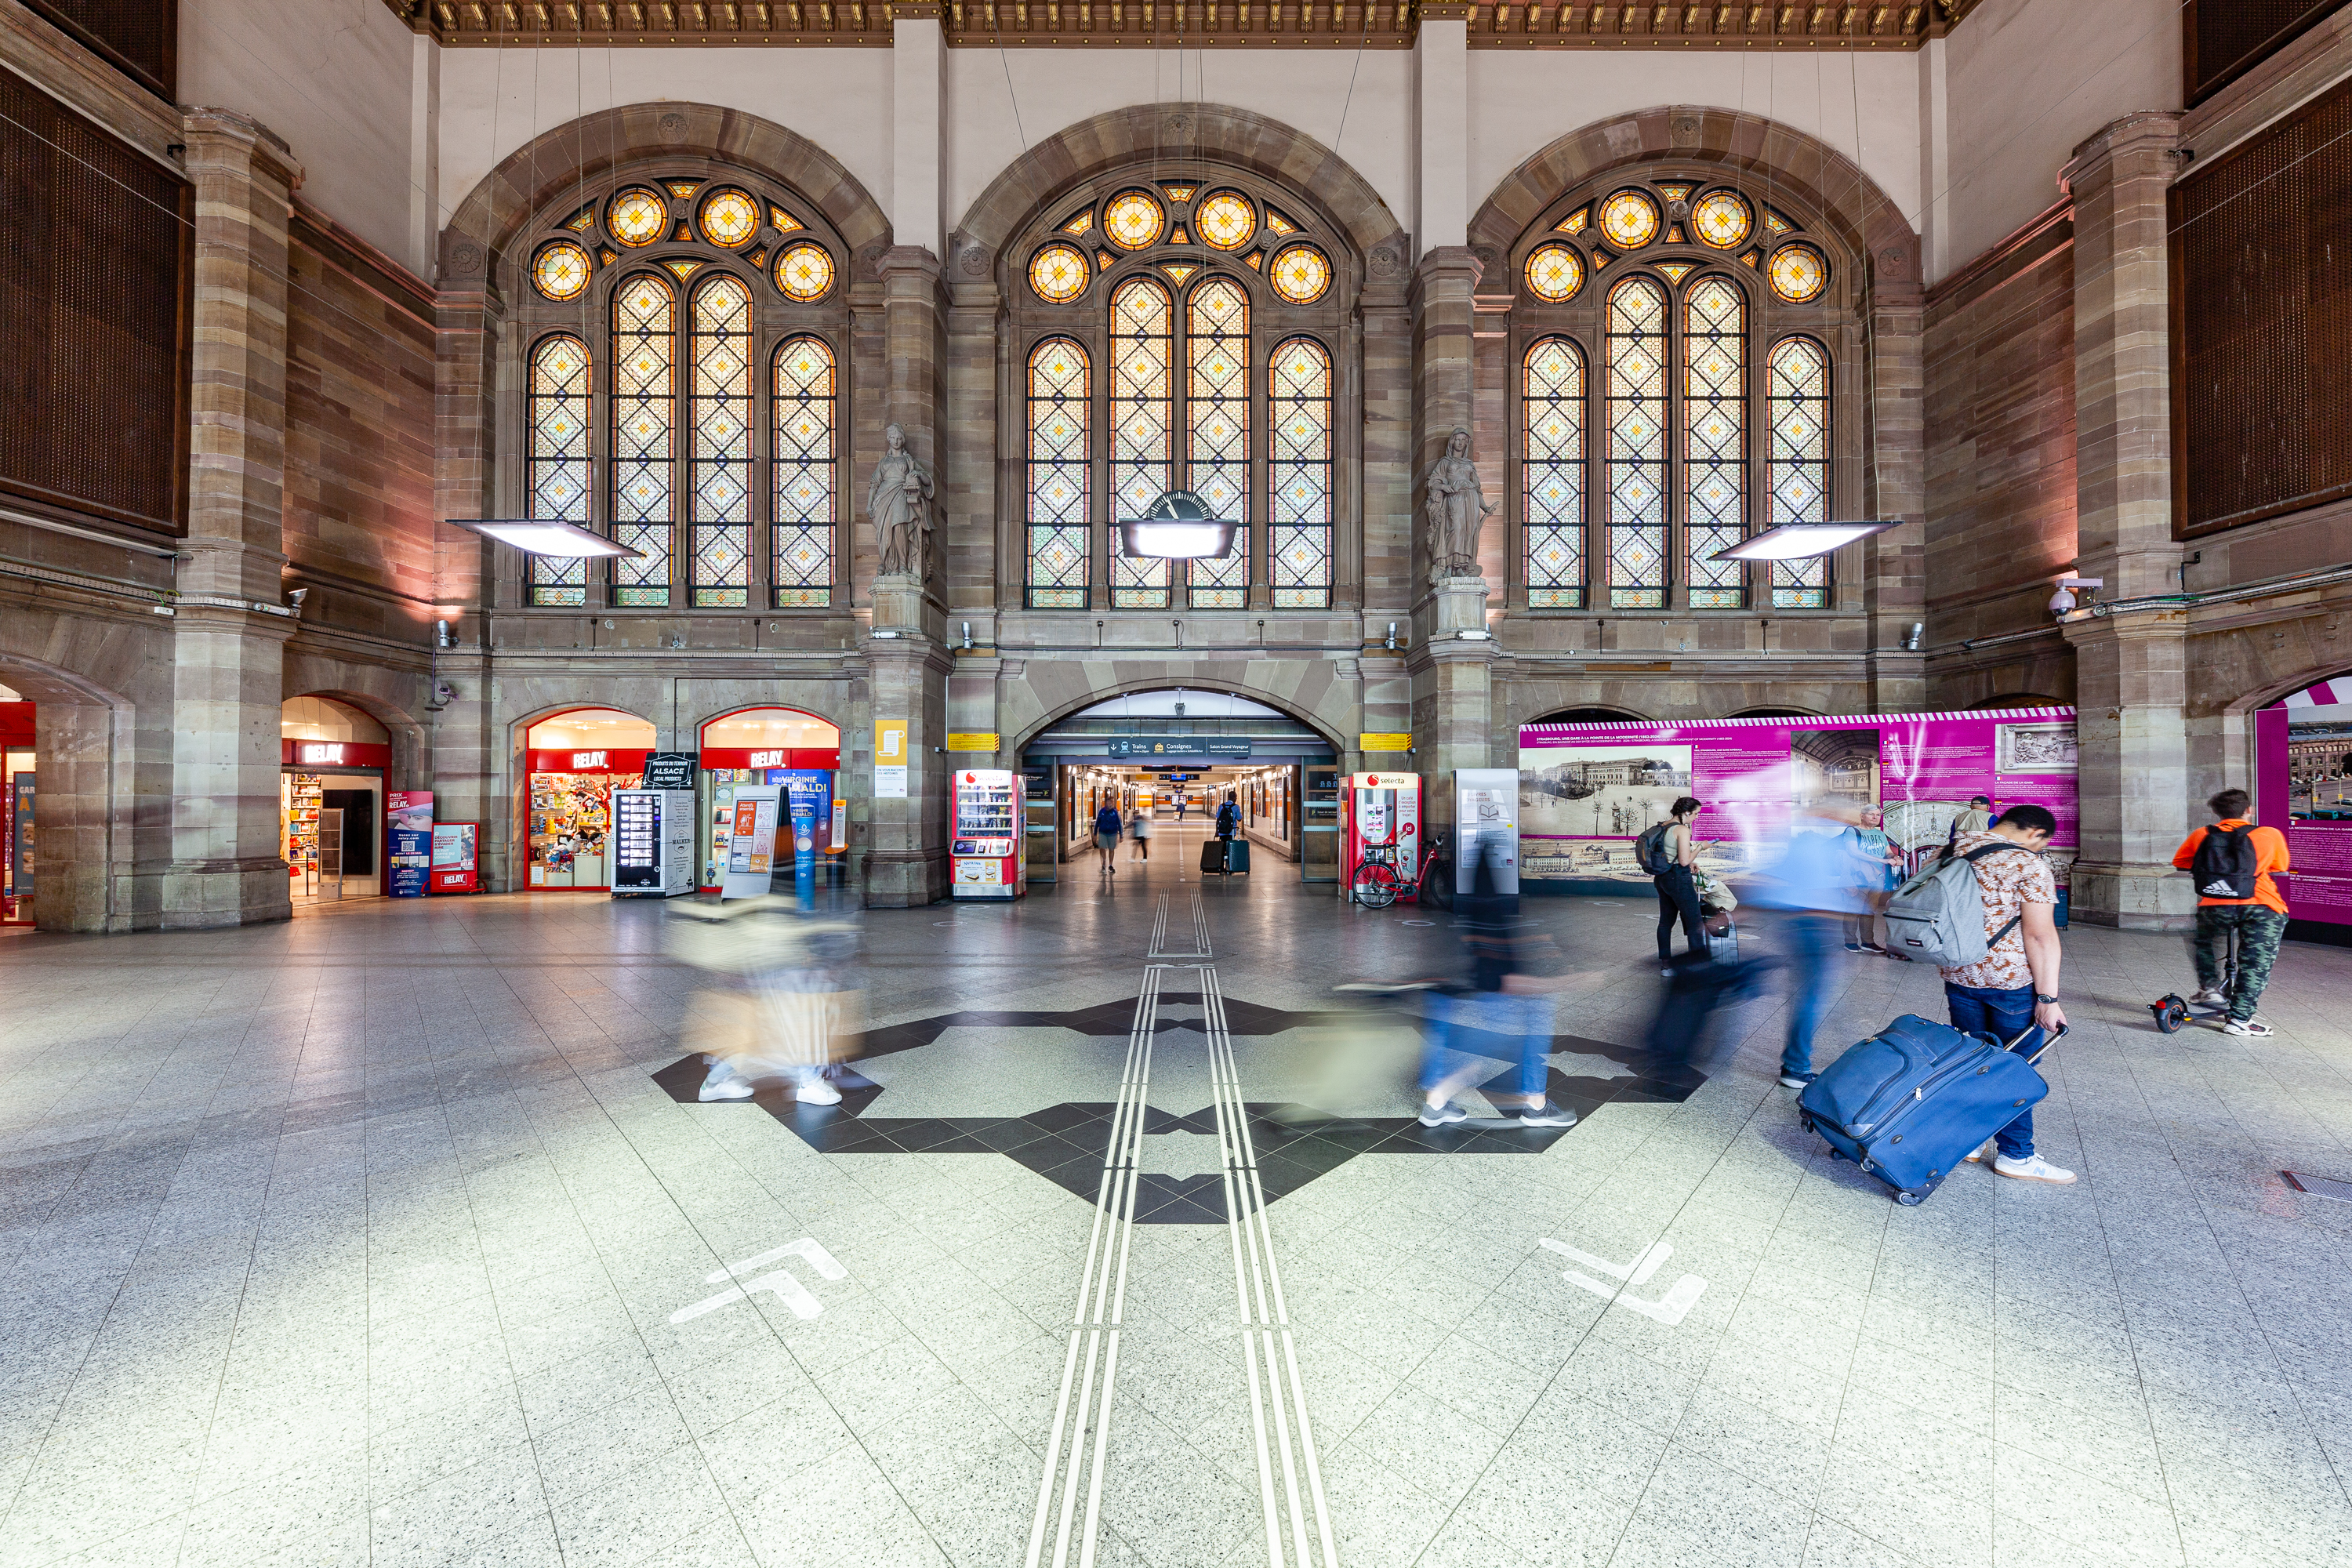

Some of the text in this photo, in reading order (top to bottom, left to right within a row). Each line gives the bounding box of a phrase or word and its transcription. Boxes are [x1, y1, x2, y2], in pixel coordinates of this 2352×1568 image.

[573, 751, 607, 769] RELAY
[751, 750, 783, 768] RELAY
[773, 784, 826, 793] IMALDI
[444, 874, 463, 884] RELAY
